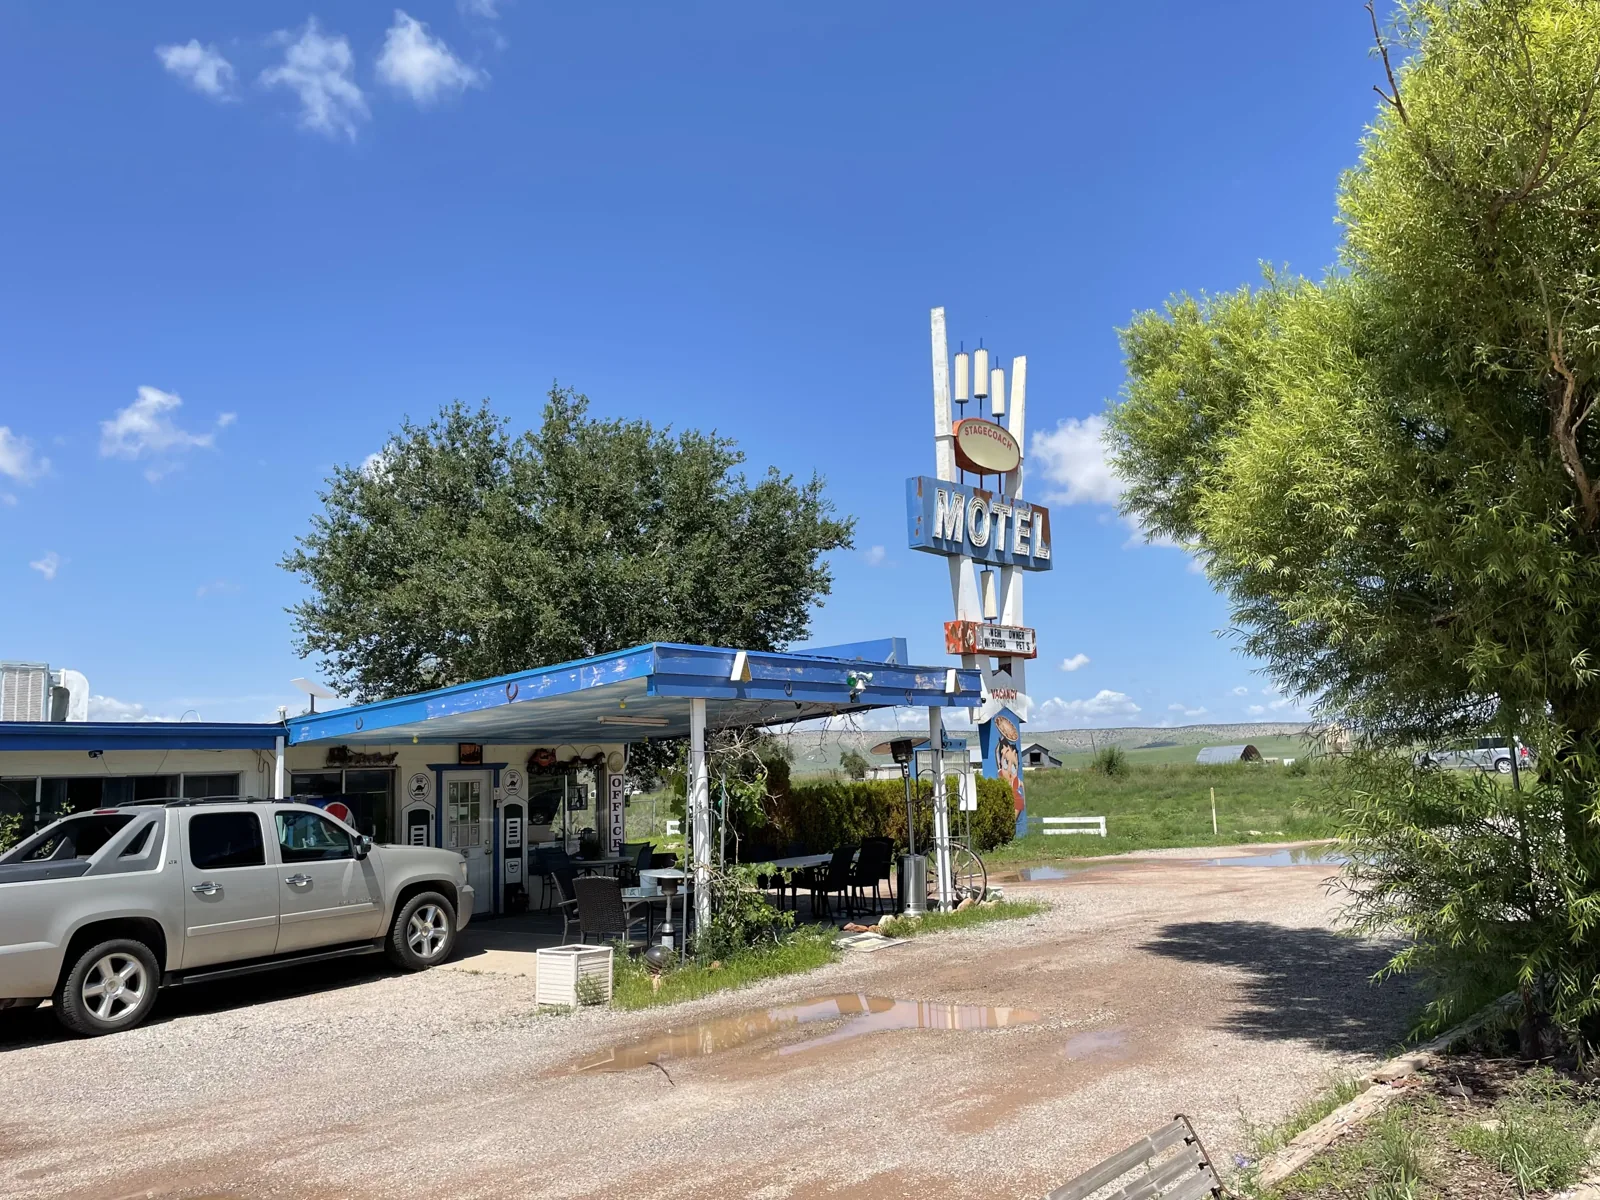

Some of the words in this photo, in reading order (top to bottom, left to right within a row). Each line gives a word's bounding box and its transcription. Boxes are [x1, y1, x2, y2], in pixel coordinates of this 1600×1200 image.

[964, 426, 1012, 451] STAGECOACH
[932, 487, 1050, 560] MOTEL
[1009, 630, 1025, 640] OWNER
[991, 688, 1018, 700] VACANCY
[611, 778, 622, 848] OFFICE
